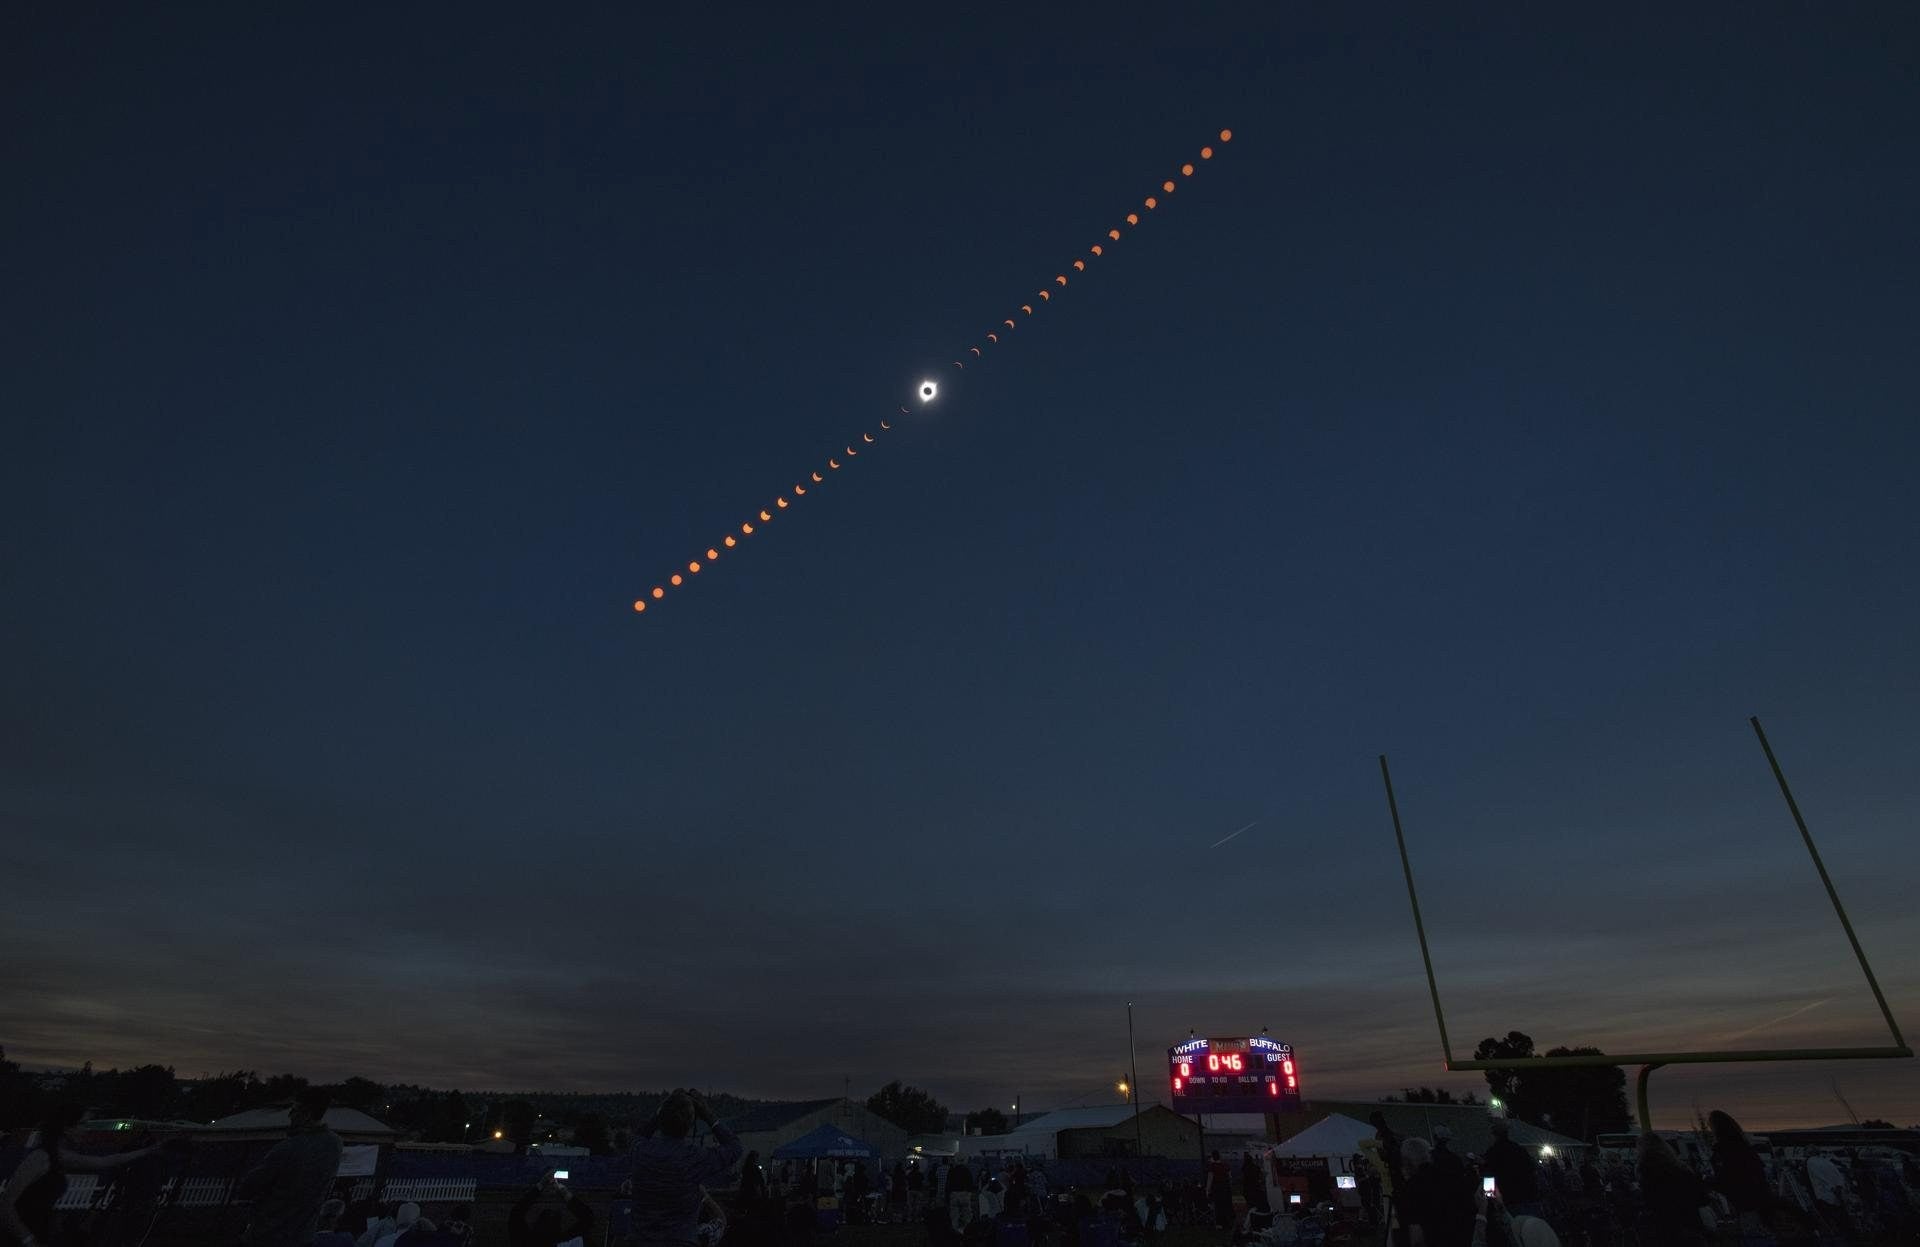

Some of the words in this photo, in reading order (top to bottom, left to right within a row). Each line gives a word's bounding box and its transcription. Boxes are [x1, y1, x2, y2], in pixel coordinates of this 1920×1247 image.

[1174, 1039, 1208, 1055] WHITE
[1249, 1038, 1291, 1053] BUFFALO
[1172, 1055, 1193, 1064] HOME
[1267, 1053, 1290, 1062] GUEST
[1181, 1063, 1189, 1077] 0
[1283, 1060, 1293, 1075] 0
[1174, 1078, 1181, 1089] 3
[1288, 1076, 1295, 1087] 3
[1271, 1083, 1277, 1095] 1
